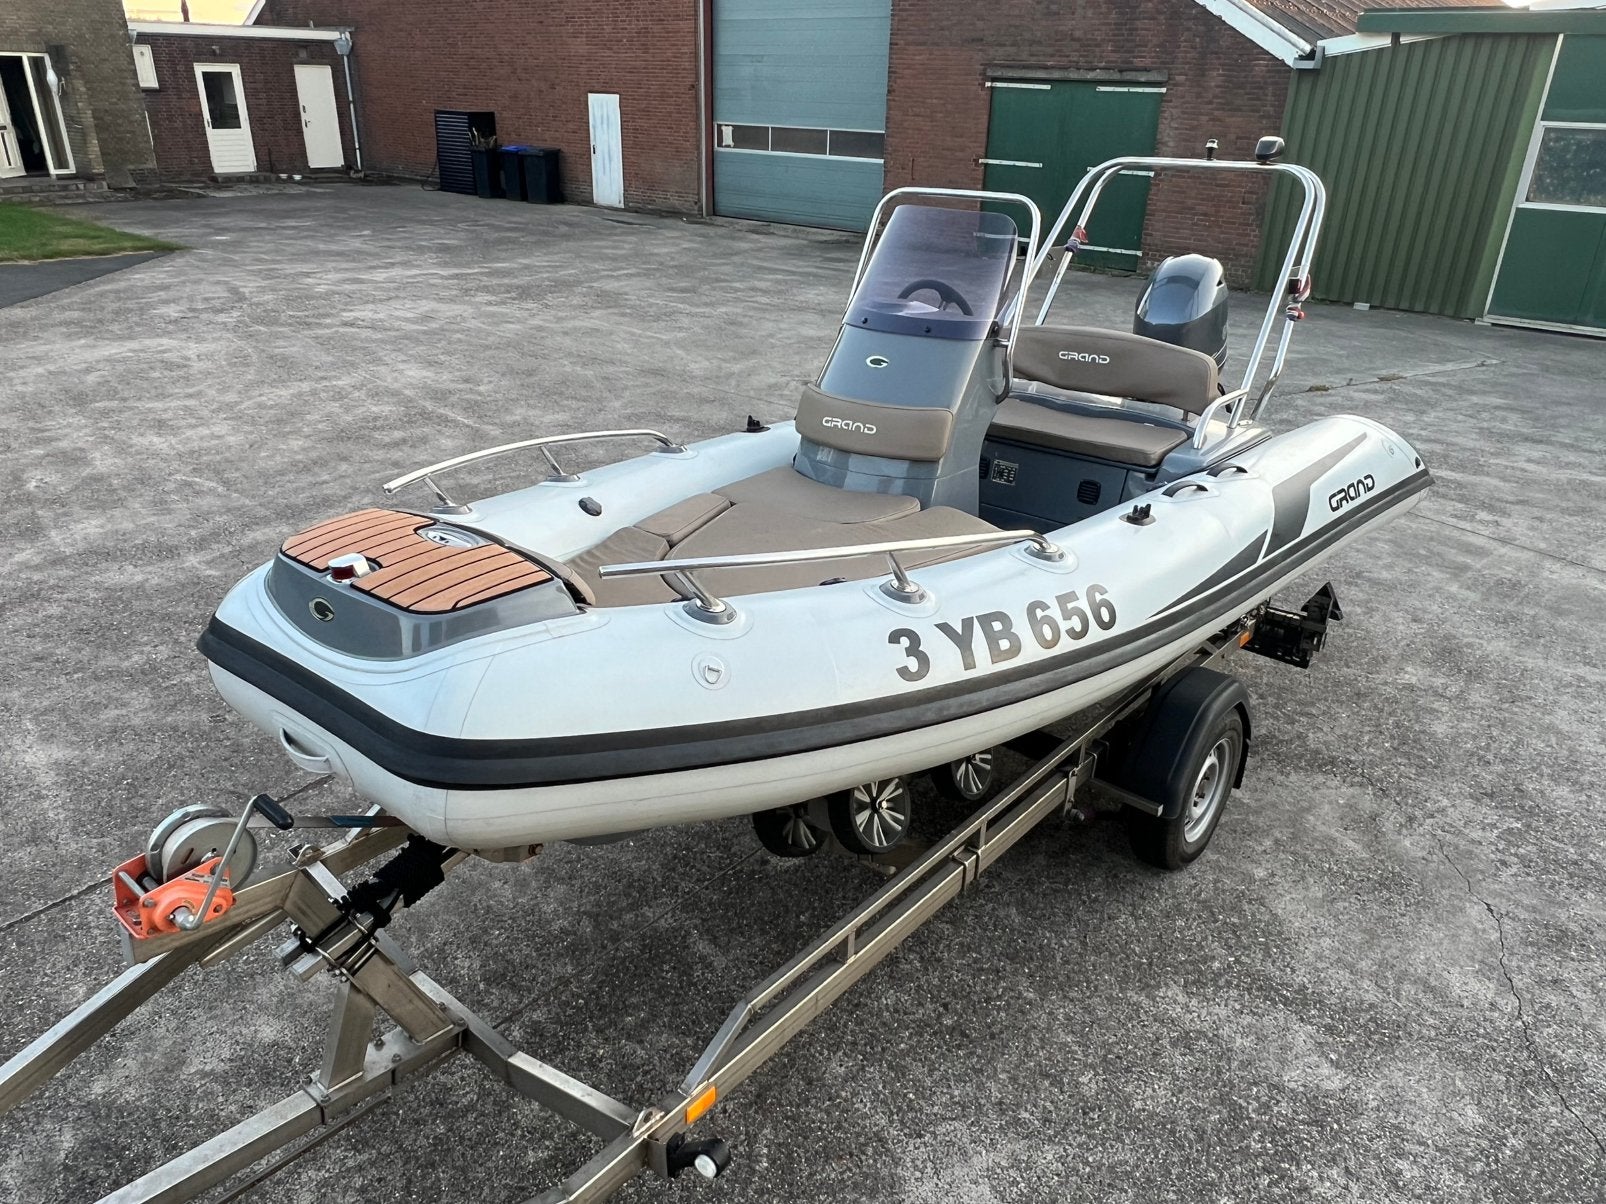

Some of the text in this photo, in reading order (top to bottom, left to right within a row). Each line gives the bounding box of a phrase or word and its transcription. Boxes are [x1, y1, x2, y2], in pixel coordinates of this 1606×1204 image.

[1058, 351, 1110, 364] GRAND
[822, 416, 877, 434] GRAND
[1328, 473, 1375, 512] GRAND
[887, 583, 1117, 683] 3 YB 656
